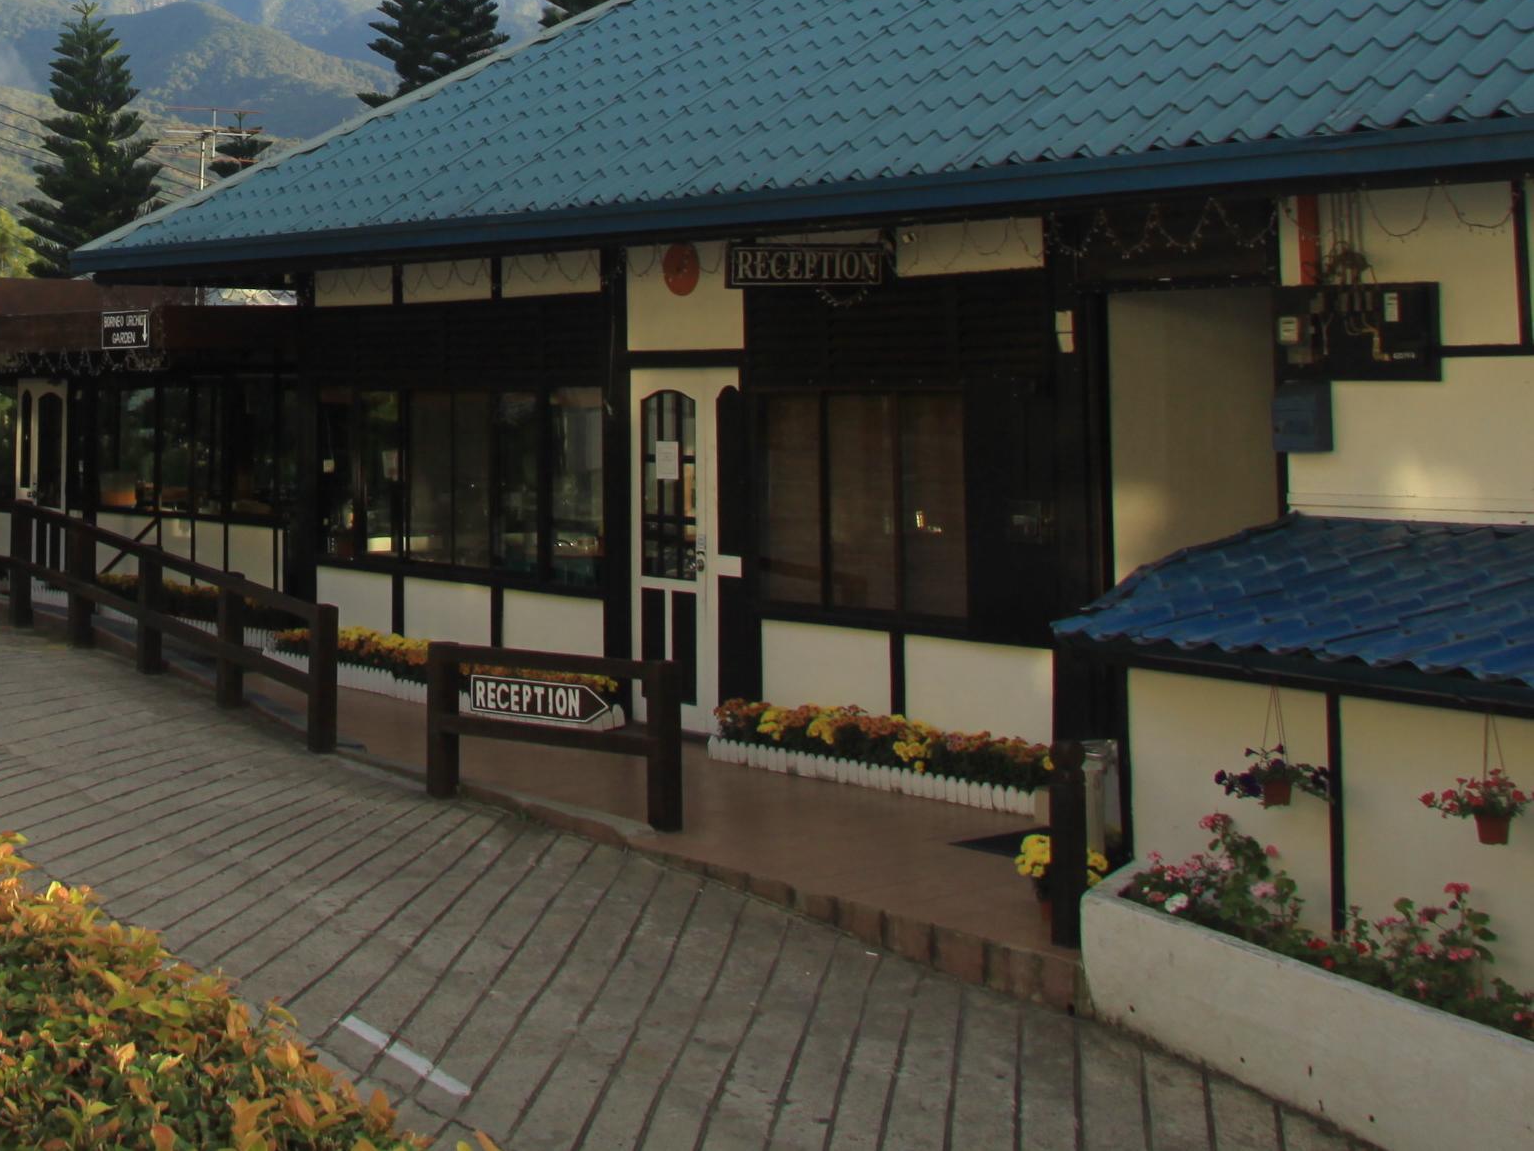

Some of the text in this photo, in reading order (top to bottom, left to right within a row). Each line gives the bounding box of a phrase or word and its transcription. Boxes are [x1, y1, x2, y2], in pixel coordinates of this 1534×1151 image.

[737, 250, 876, 280] RECEPTION
[112, 331, 136, 344] GARDEN
[475, 680, 580, 717] RECEPTION
